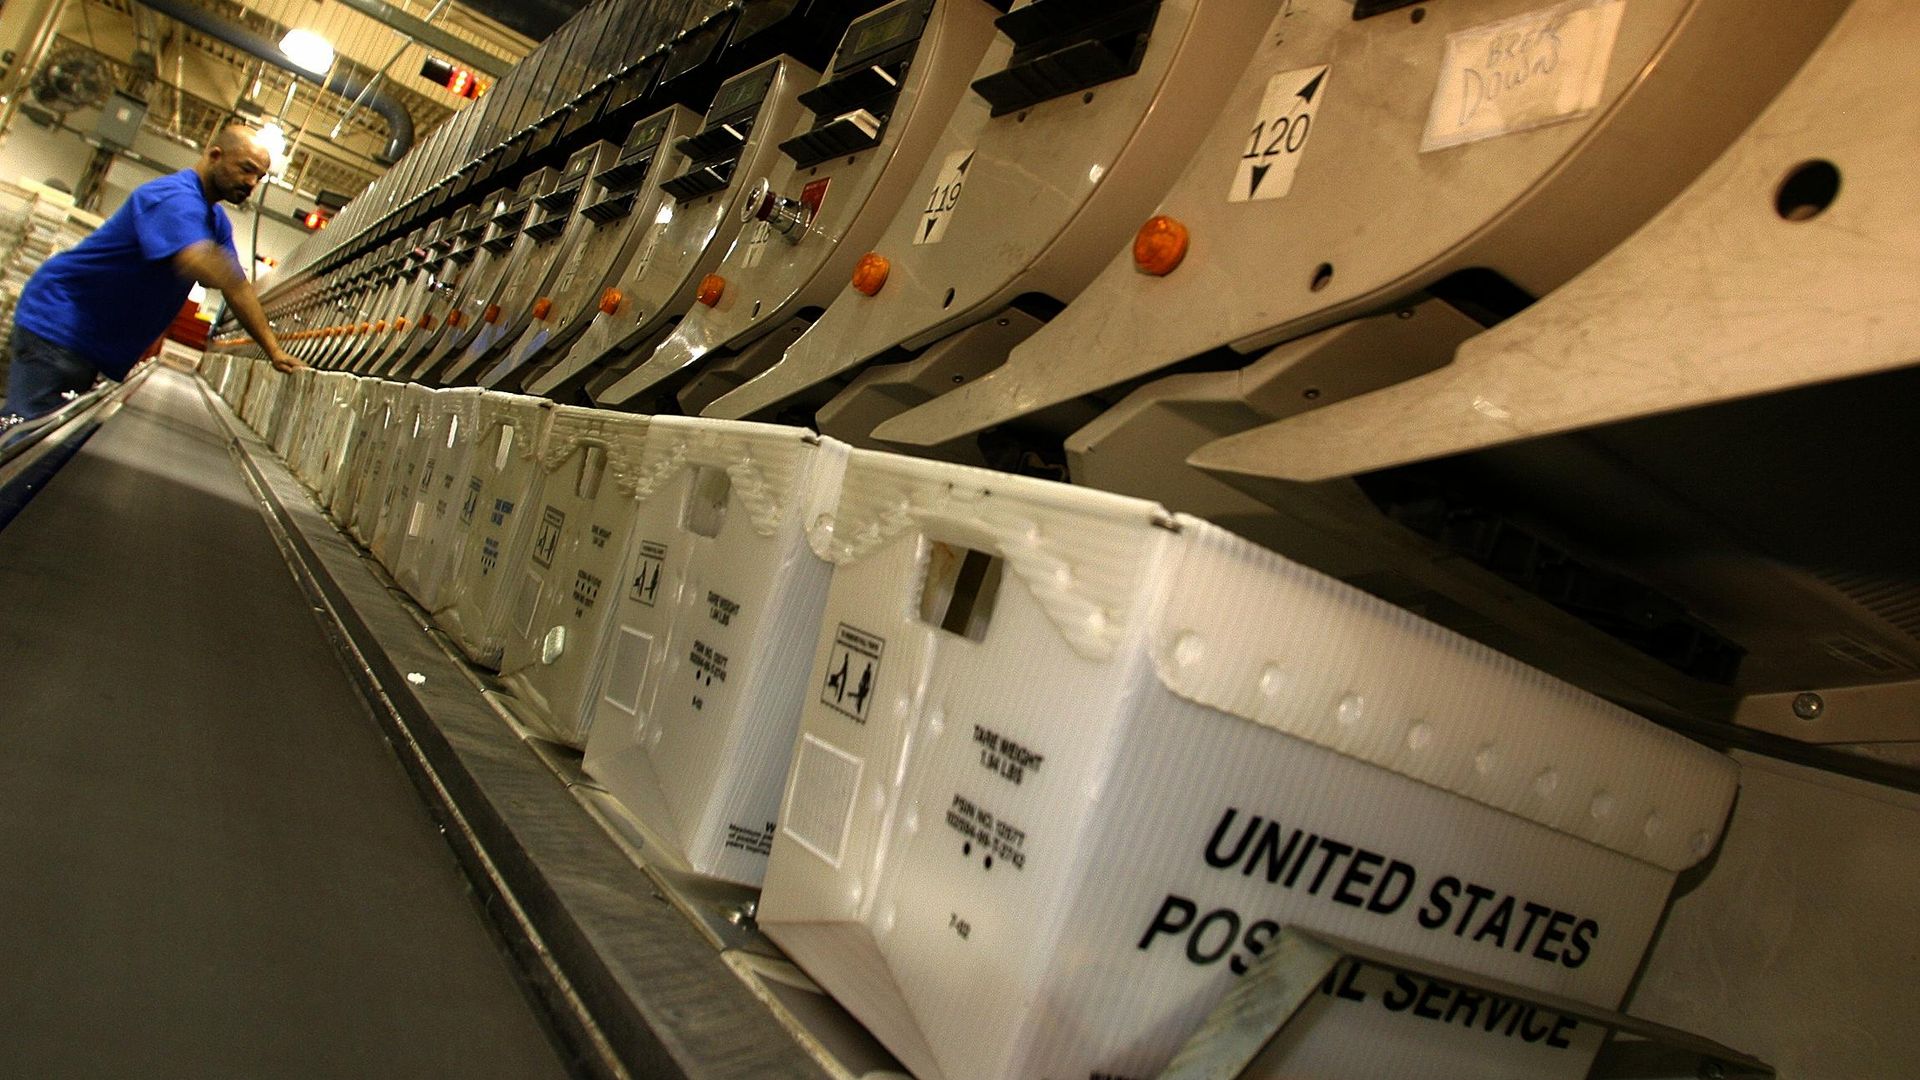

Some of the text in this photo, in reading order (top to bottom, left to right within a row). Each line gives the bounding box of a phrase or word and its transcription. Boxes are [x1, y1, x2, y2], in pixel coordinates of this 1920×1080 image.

[1242, 113, 1311, 159] 120
[924, 182, 963, 214] 119
[973, 724, 1044, 773] TARE WEIGHT
[1204, 808, 1599, 969] UNITED STATES
[1382, 963, 1578, 1050] SERVICE
